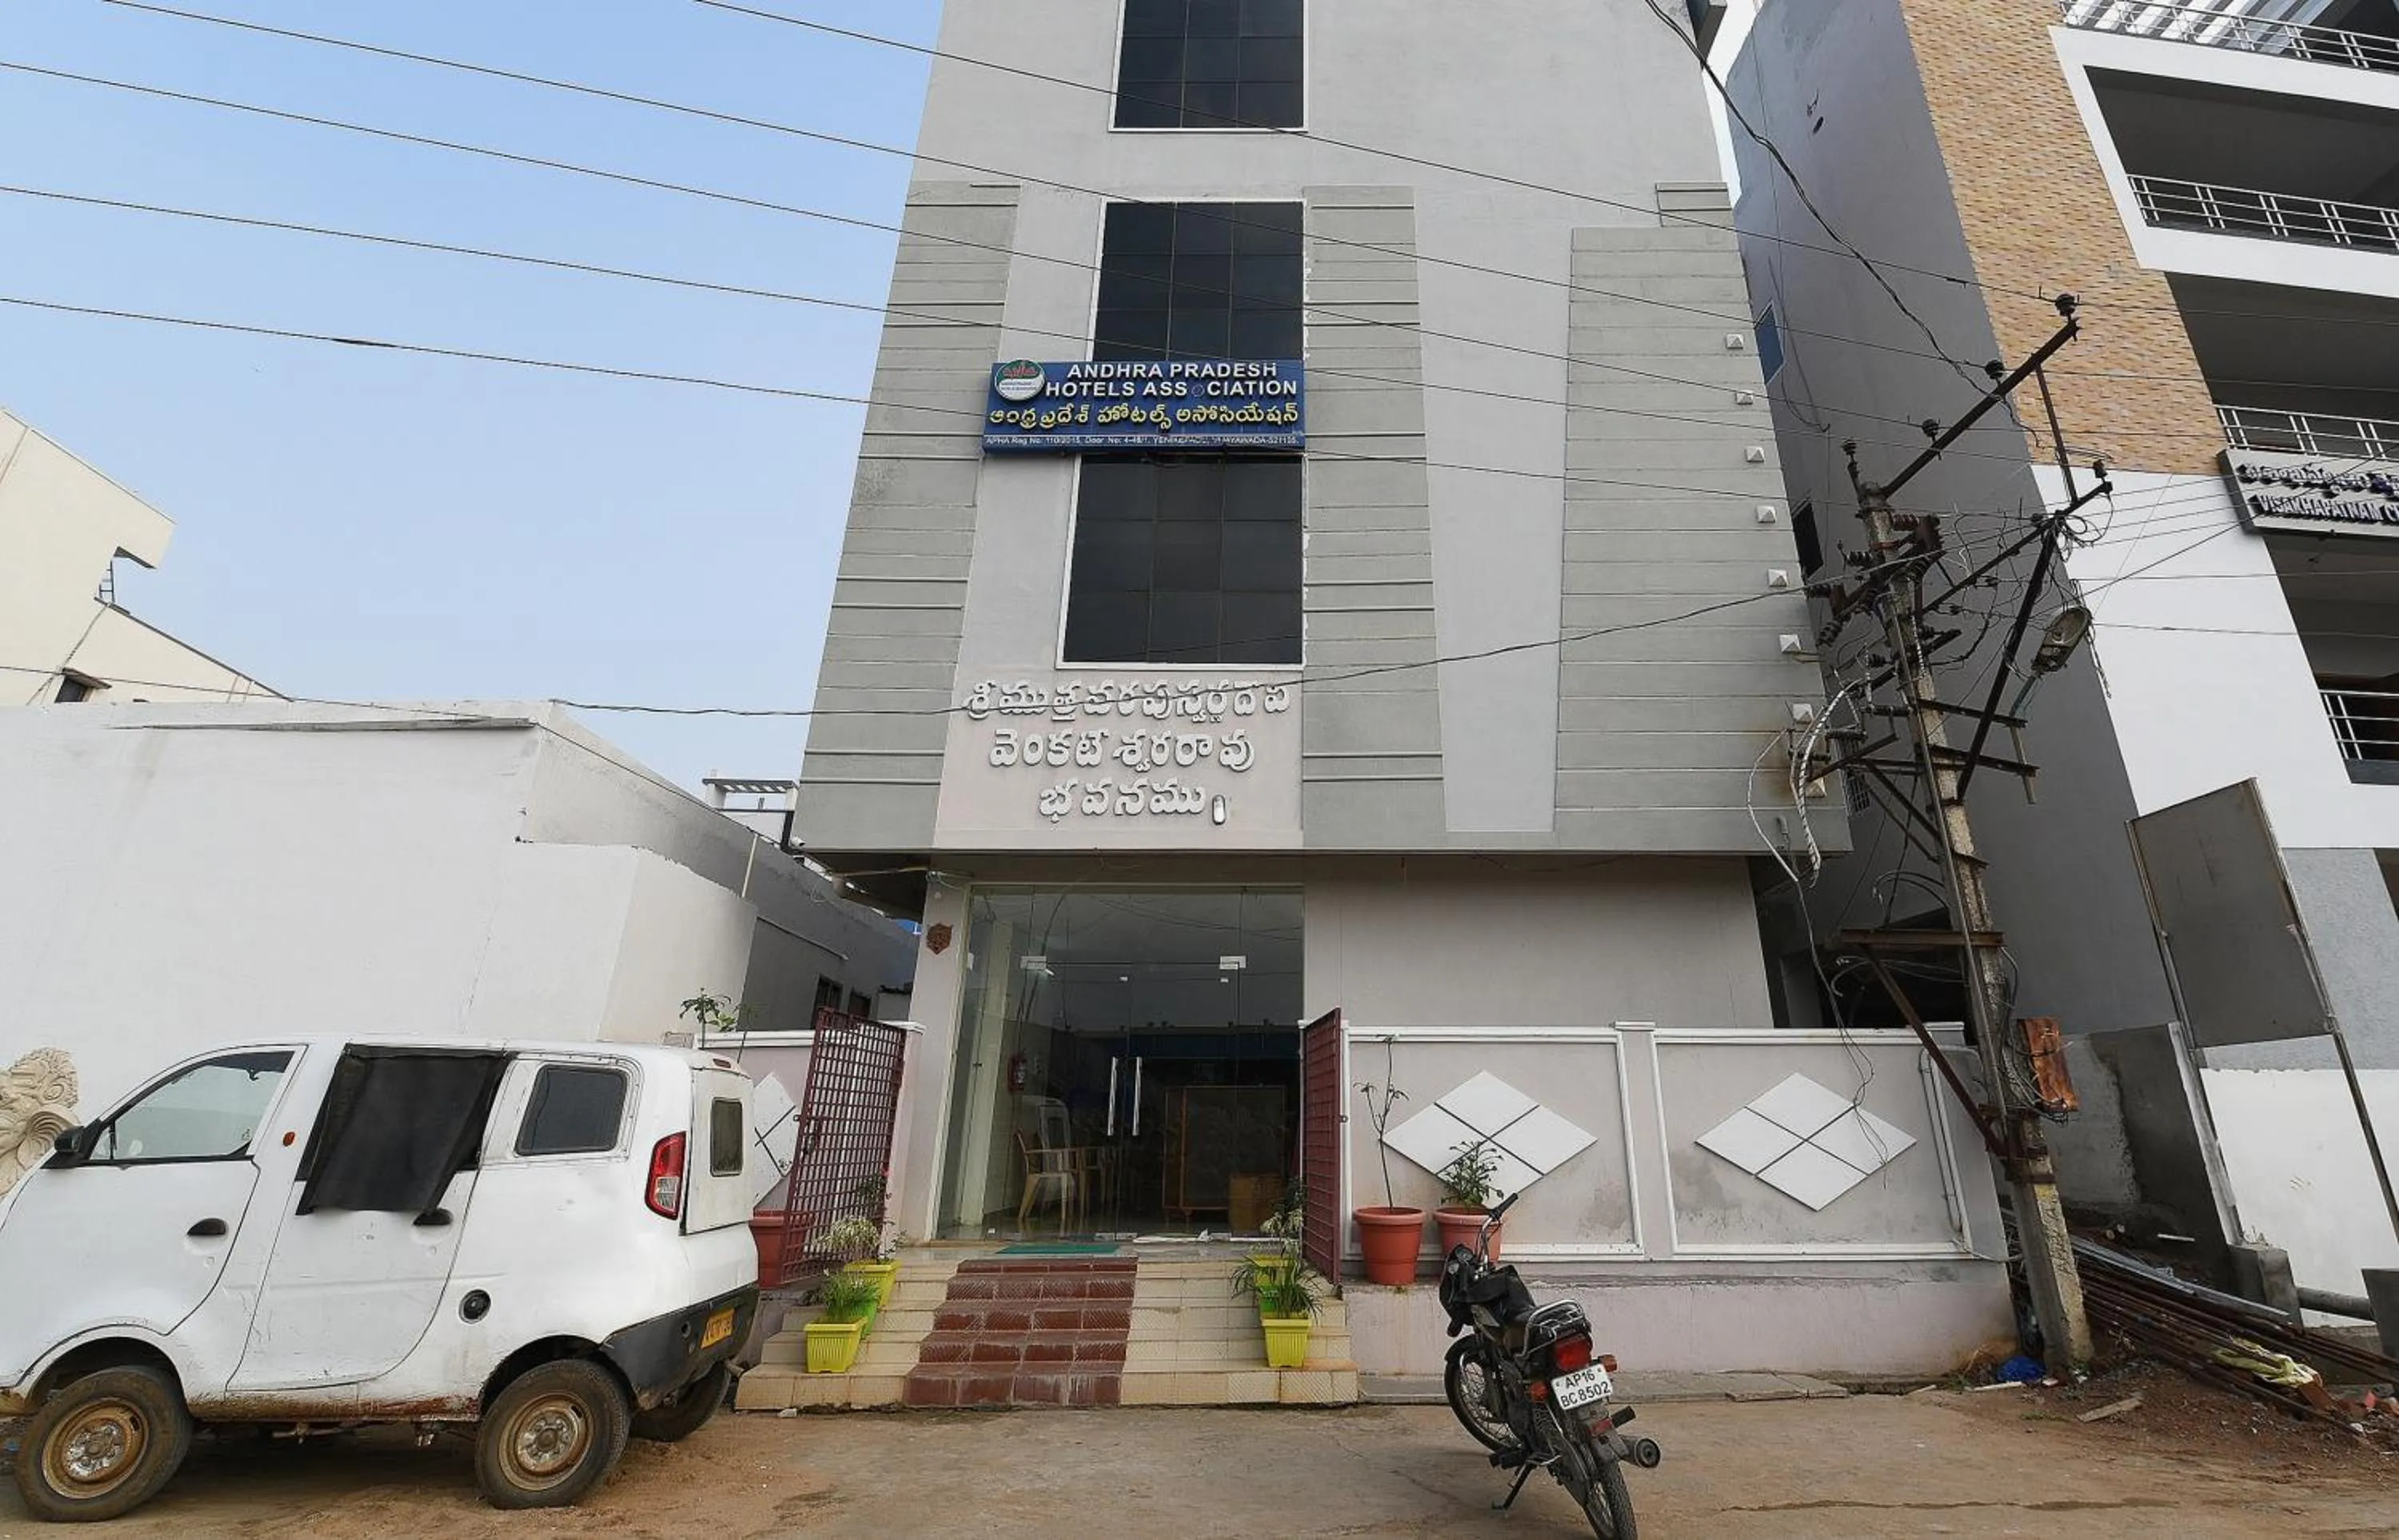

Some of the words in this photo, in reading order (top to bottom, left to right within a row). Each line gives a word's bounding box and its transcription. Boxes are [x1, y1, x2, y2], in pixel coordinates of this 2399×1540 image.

[1067, 364, 1163, 378] ANDHRA
[1170, 362, 1276, 378] PRADESH
[1045, 381, 1135, 397] HOTELS
[2257, 494, 2384, 520] VISAKHAPATNAM
[1565, 1369, 1595, 1389] AP16
